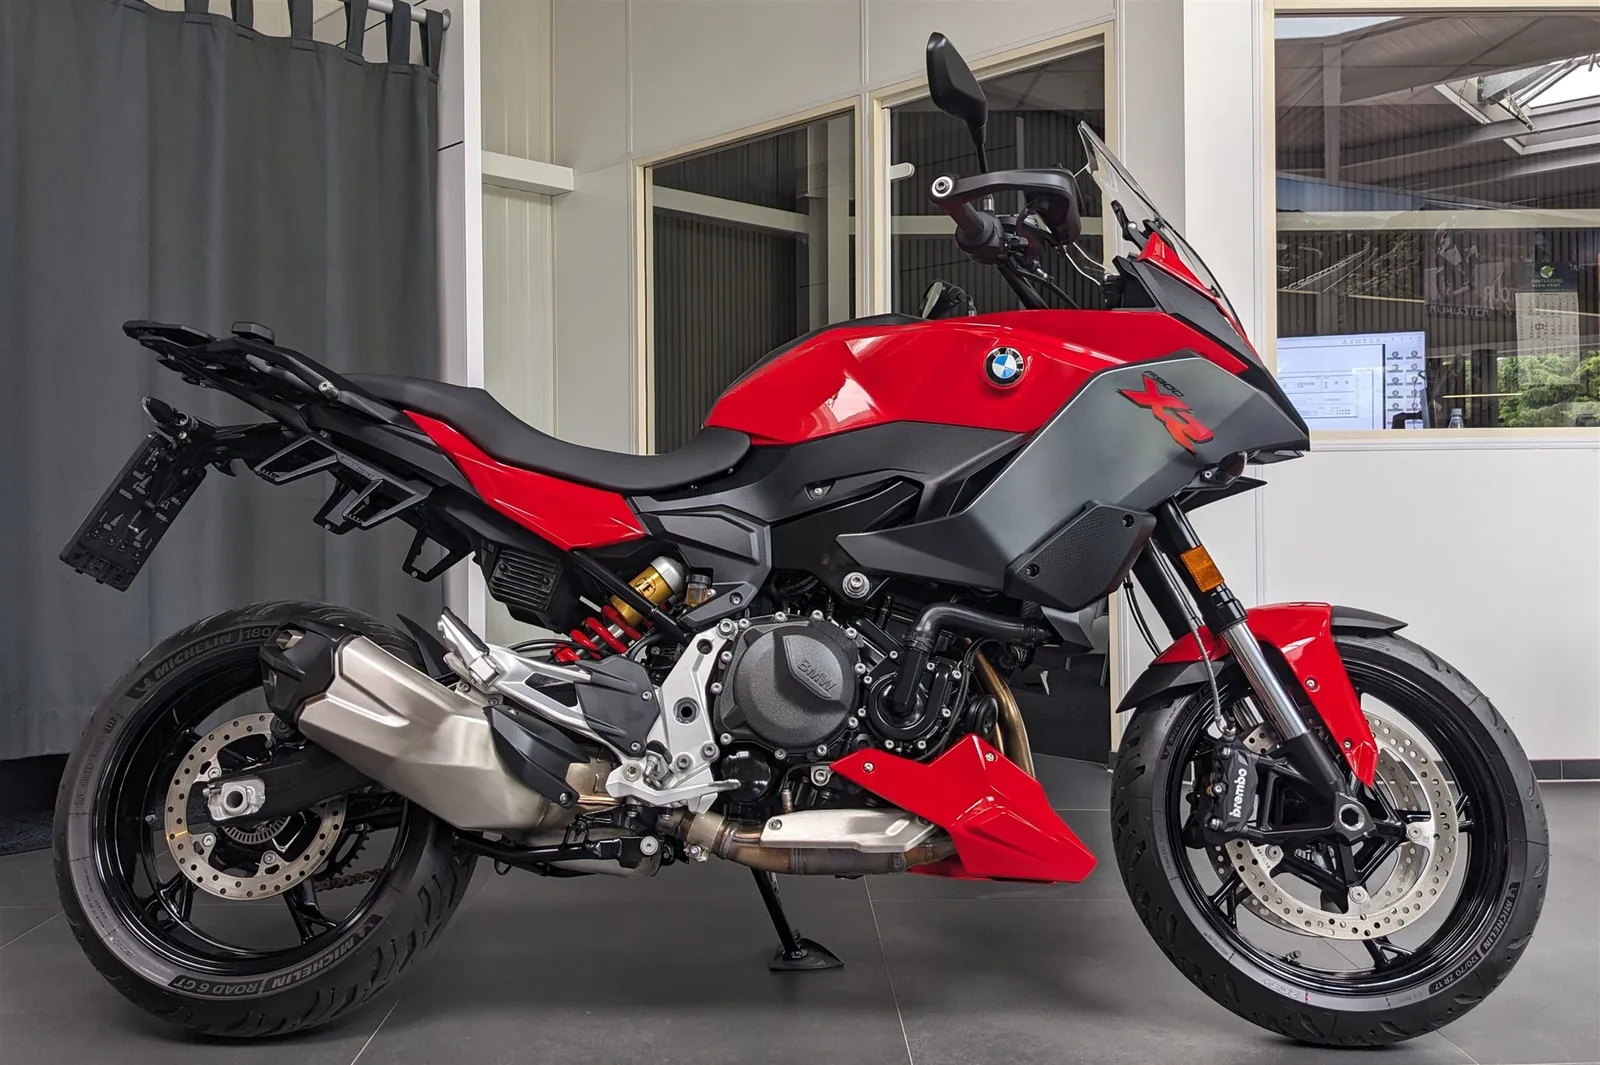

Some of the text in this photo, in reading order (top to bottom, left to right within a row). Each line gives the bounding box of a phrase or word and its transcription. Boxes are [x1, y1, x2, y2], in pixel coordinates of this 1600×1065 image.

[1117, 371, 1214, 458] XR
[154, 627, 272, 679] MICHELIN 180
[797, 658, 837, 691] BMW
[1229, 768, 1248, 818] brembo
[174, 936, 355, 995] MICHELIN ROAD 6 GT
[1434, 901, 1513, 991] MICHELIN 120/70 ZR 17
